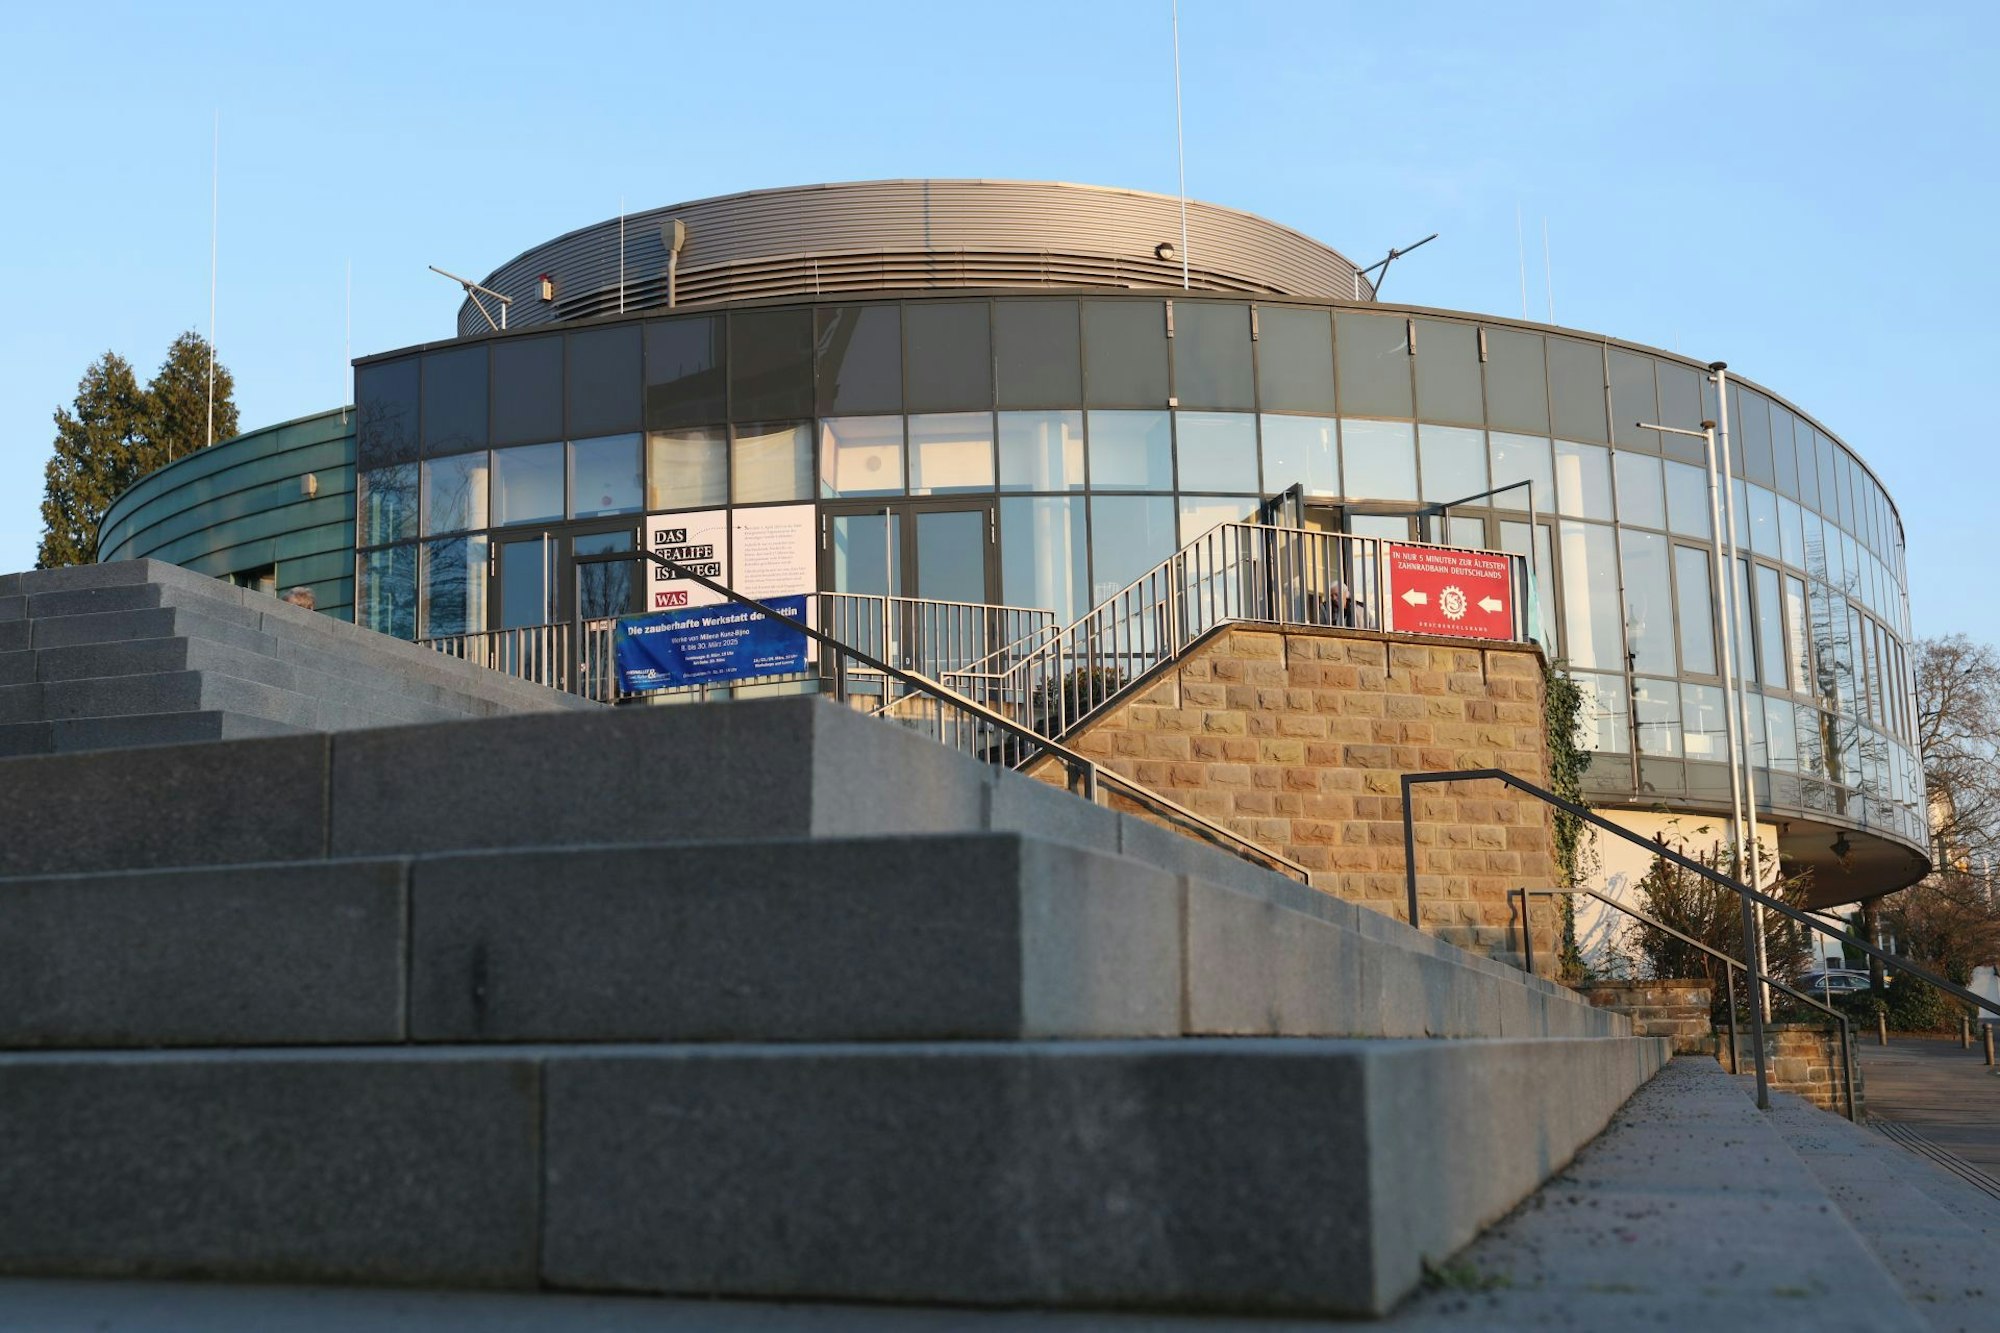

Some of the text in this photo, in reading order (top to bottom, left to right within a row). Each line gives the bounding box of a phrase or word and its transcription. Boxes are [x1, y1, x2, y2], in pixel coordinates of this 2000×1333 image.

[656, 529, 684, 544] DAS
[656, 545, 713, 560] SEALIFE
[1392, 551, 1400, 559] IN
[1402, 553, 1417, 561] NUR
[1425, 555, 1457, 565] MINUTEN
[1459, 558, 1472, 567] ZUR
[1474, 559, 1506, 570] ÄLTESTEN
[1398, 561, 1502, 579] ZAHNRADBAHN DEUTSCHLANDS
[656, 593, 686, 606] WAS
[628, 626, 643, 635] Die
[644, 620, 700, 634] zauberhafte
[702, 613, 748, 627] Werkstatt
[697, 642, 707, 650] 30.
[707, 640, 722, 649] März
